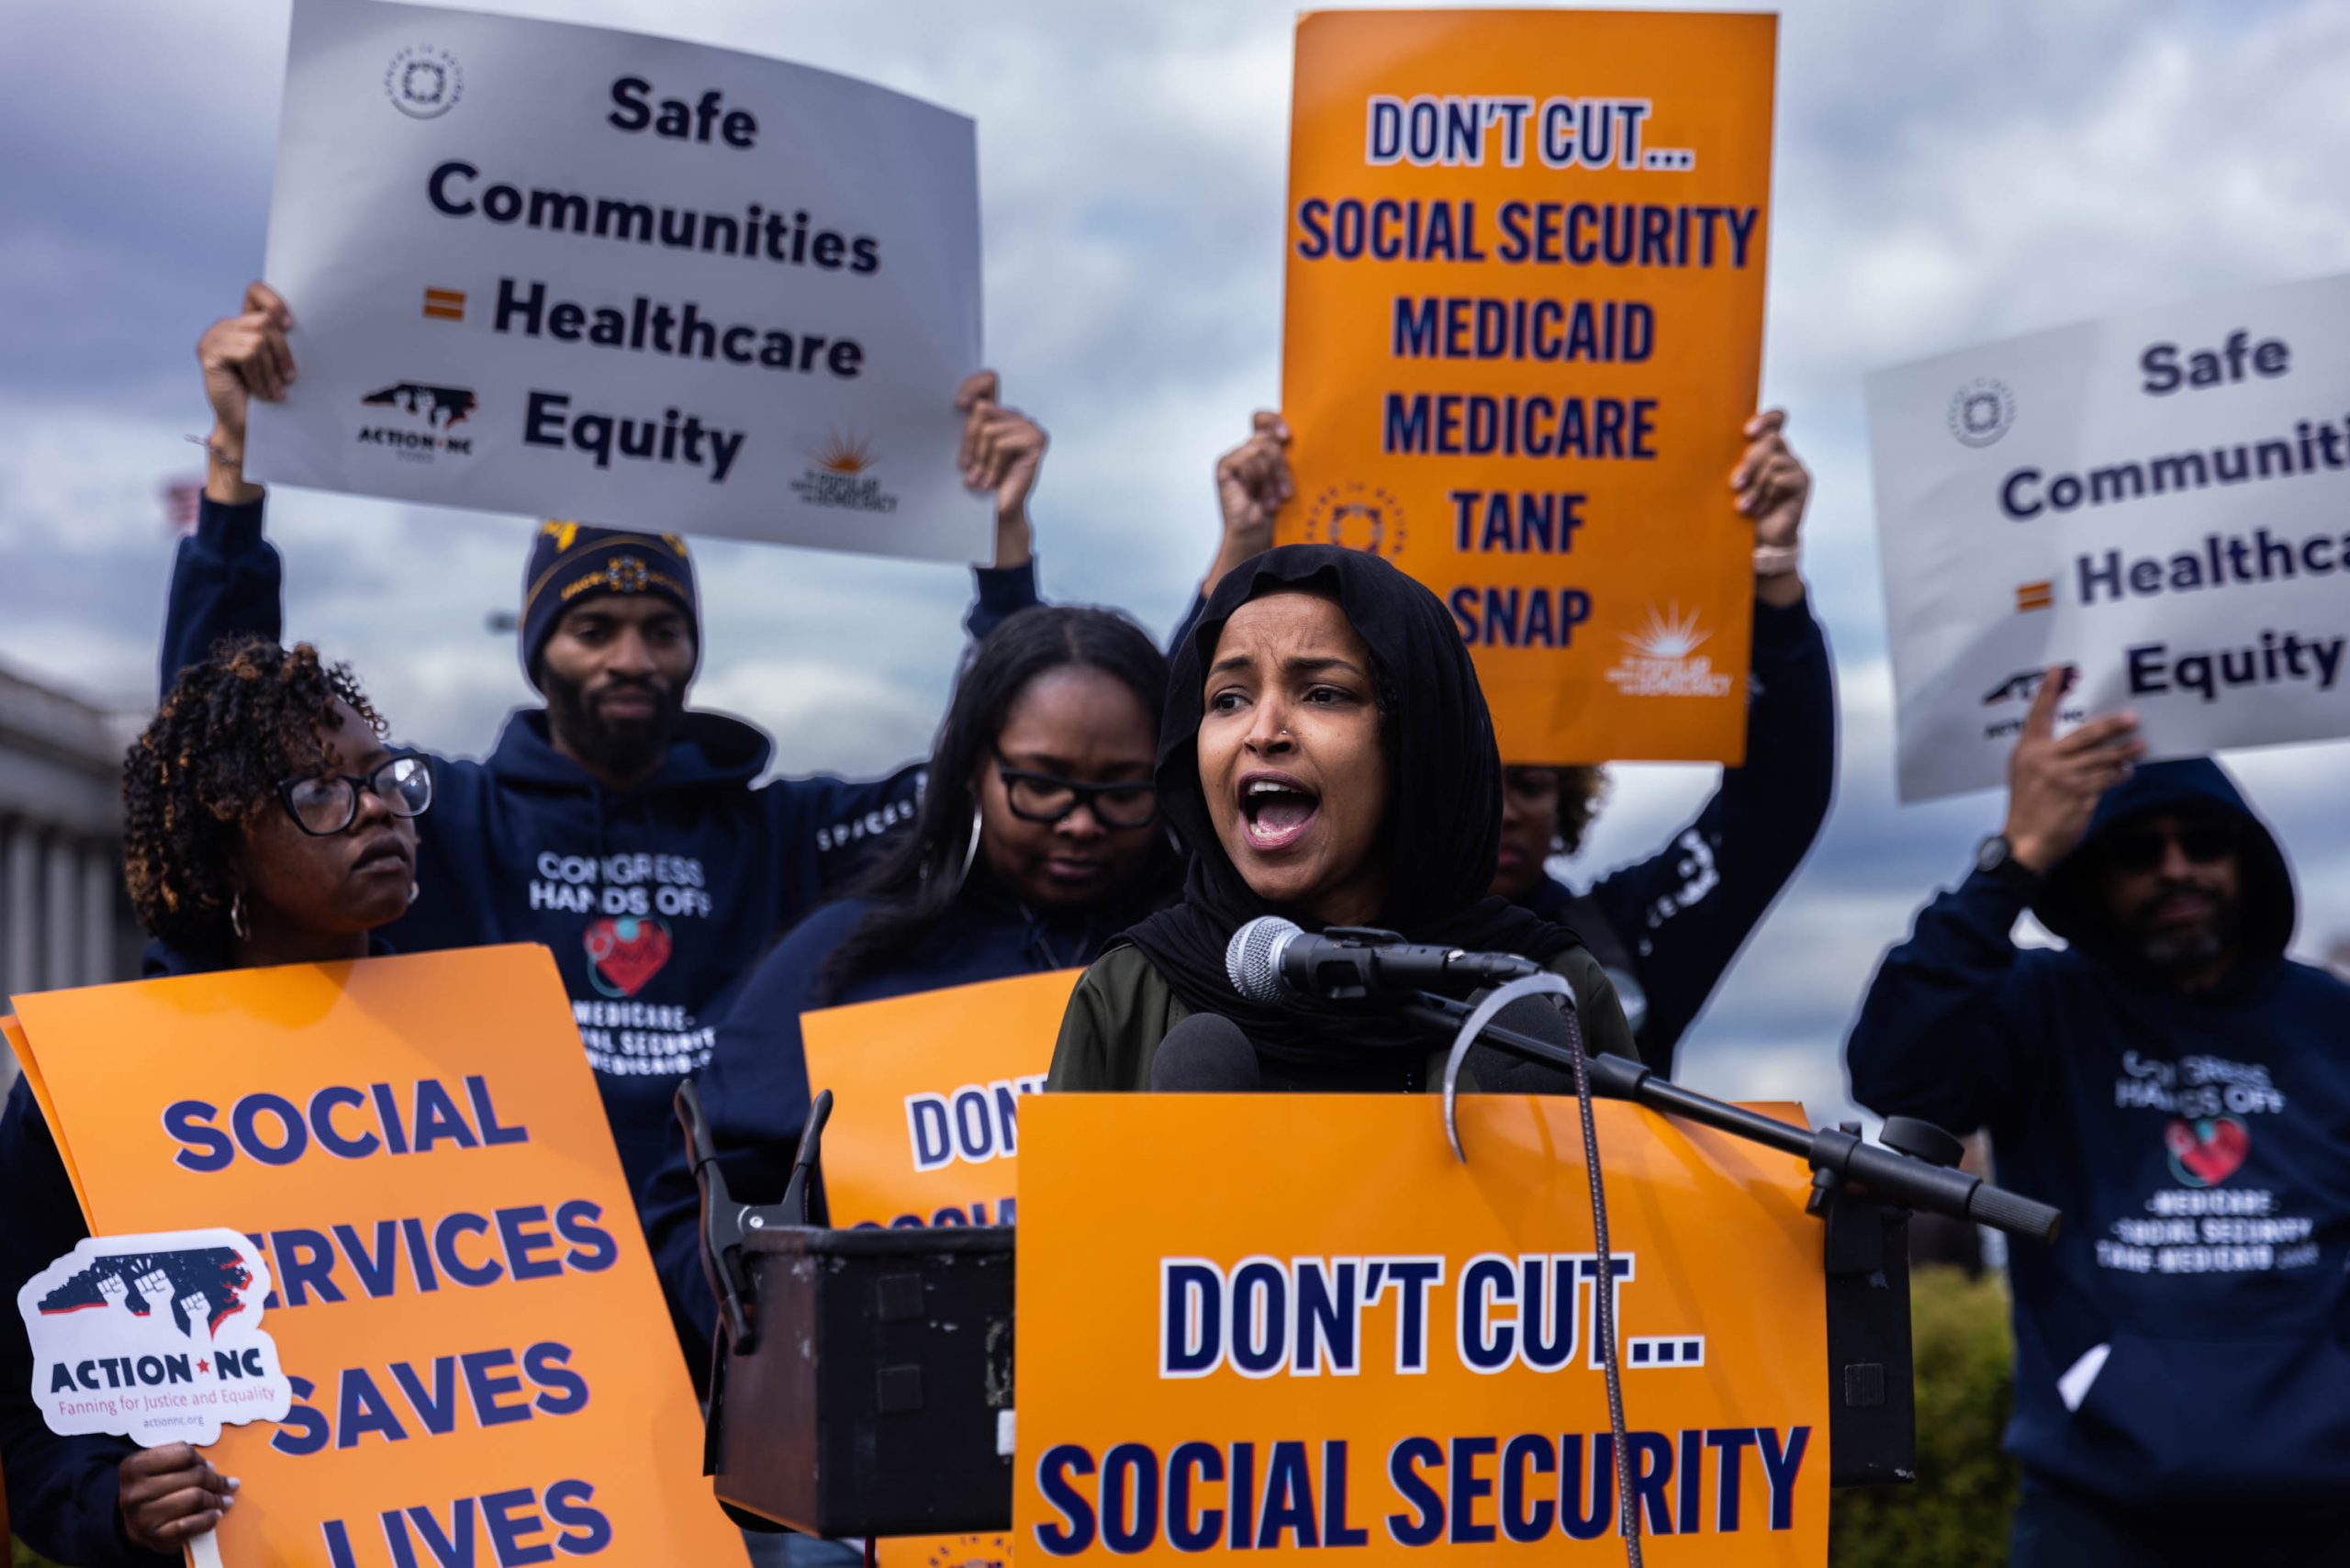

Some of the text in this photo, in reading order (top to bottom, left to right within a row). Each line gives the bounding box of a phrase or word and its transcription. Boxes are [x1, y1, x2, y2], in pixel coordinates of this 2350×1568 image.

[608, 75, 758, 149] Safe
[1365, 95, 1695, 171] DON'T CUT...
[428, 161, 880, 274] Communities
[1296, 197, 1758, 269] SOCIAL SECURITY
[493, 278, 865, 378] Healthcare
[1392, 296, 1654, 363] MEDICAID
[2138, 328, 2291, 397] Safe
[359, 425, 435, 452] ACTION
[523, 390, 746, 486] Equity
[1382, 393, 1658, 459] MEDICARE
[1449, 490, 1588, 554] TANF
[1449, 585, 1592, 648] SNAP
[2125, 628, 2346, 703] Equity
[162, 1074, 530, 1173] SOCIAL
[1158, 1252, 1705, 1380] DON'T CUT...
[50, 1348, 264, 1394] ACTION NC
[58, 1387, 275, 1417] Fanning for Justice and Equality
[271, 1340, 589, 1456] SAVES
[143, 1415, 205, 1428] actionnc.org
[1033, 1425, 1813, 1556] SOCIAL SECURITY
